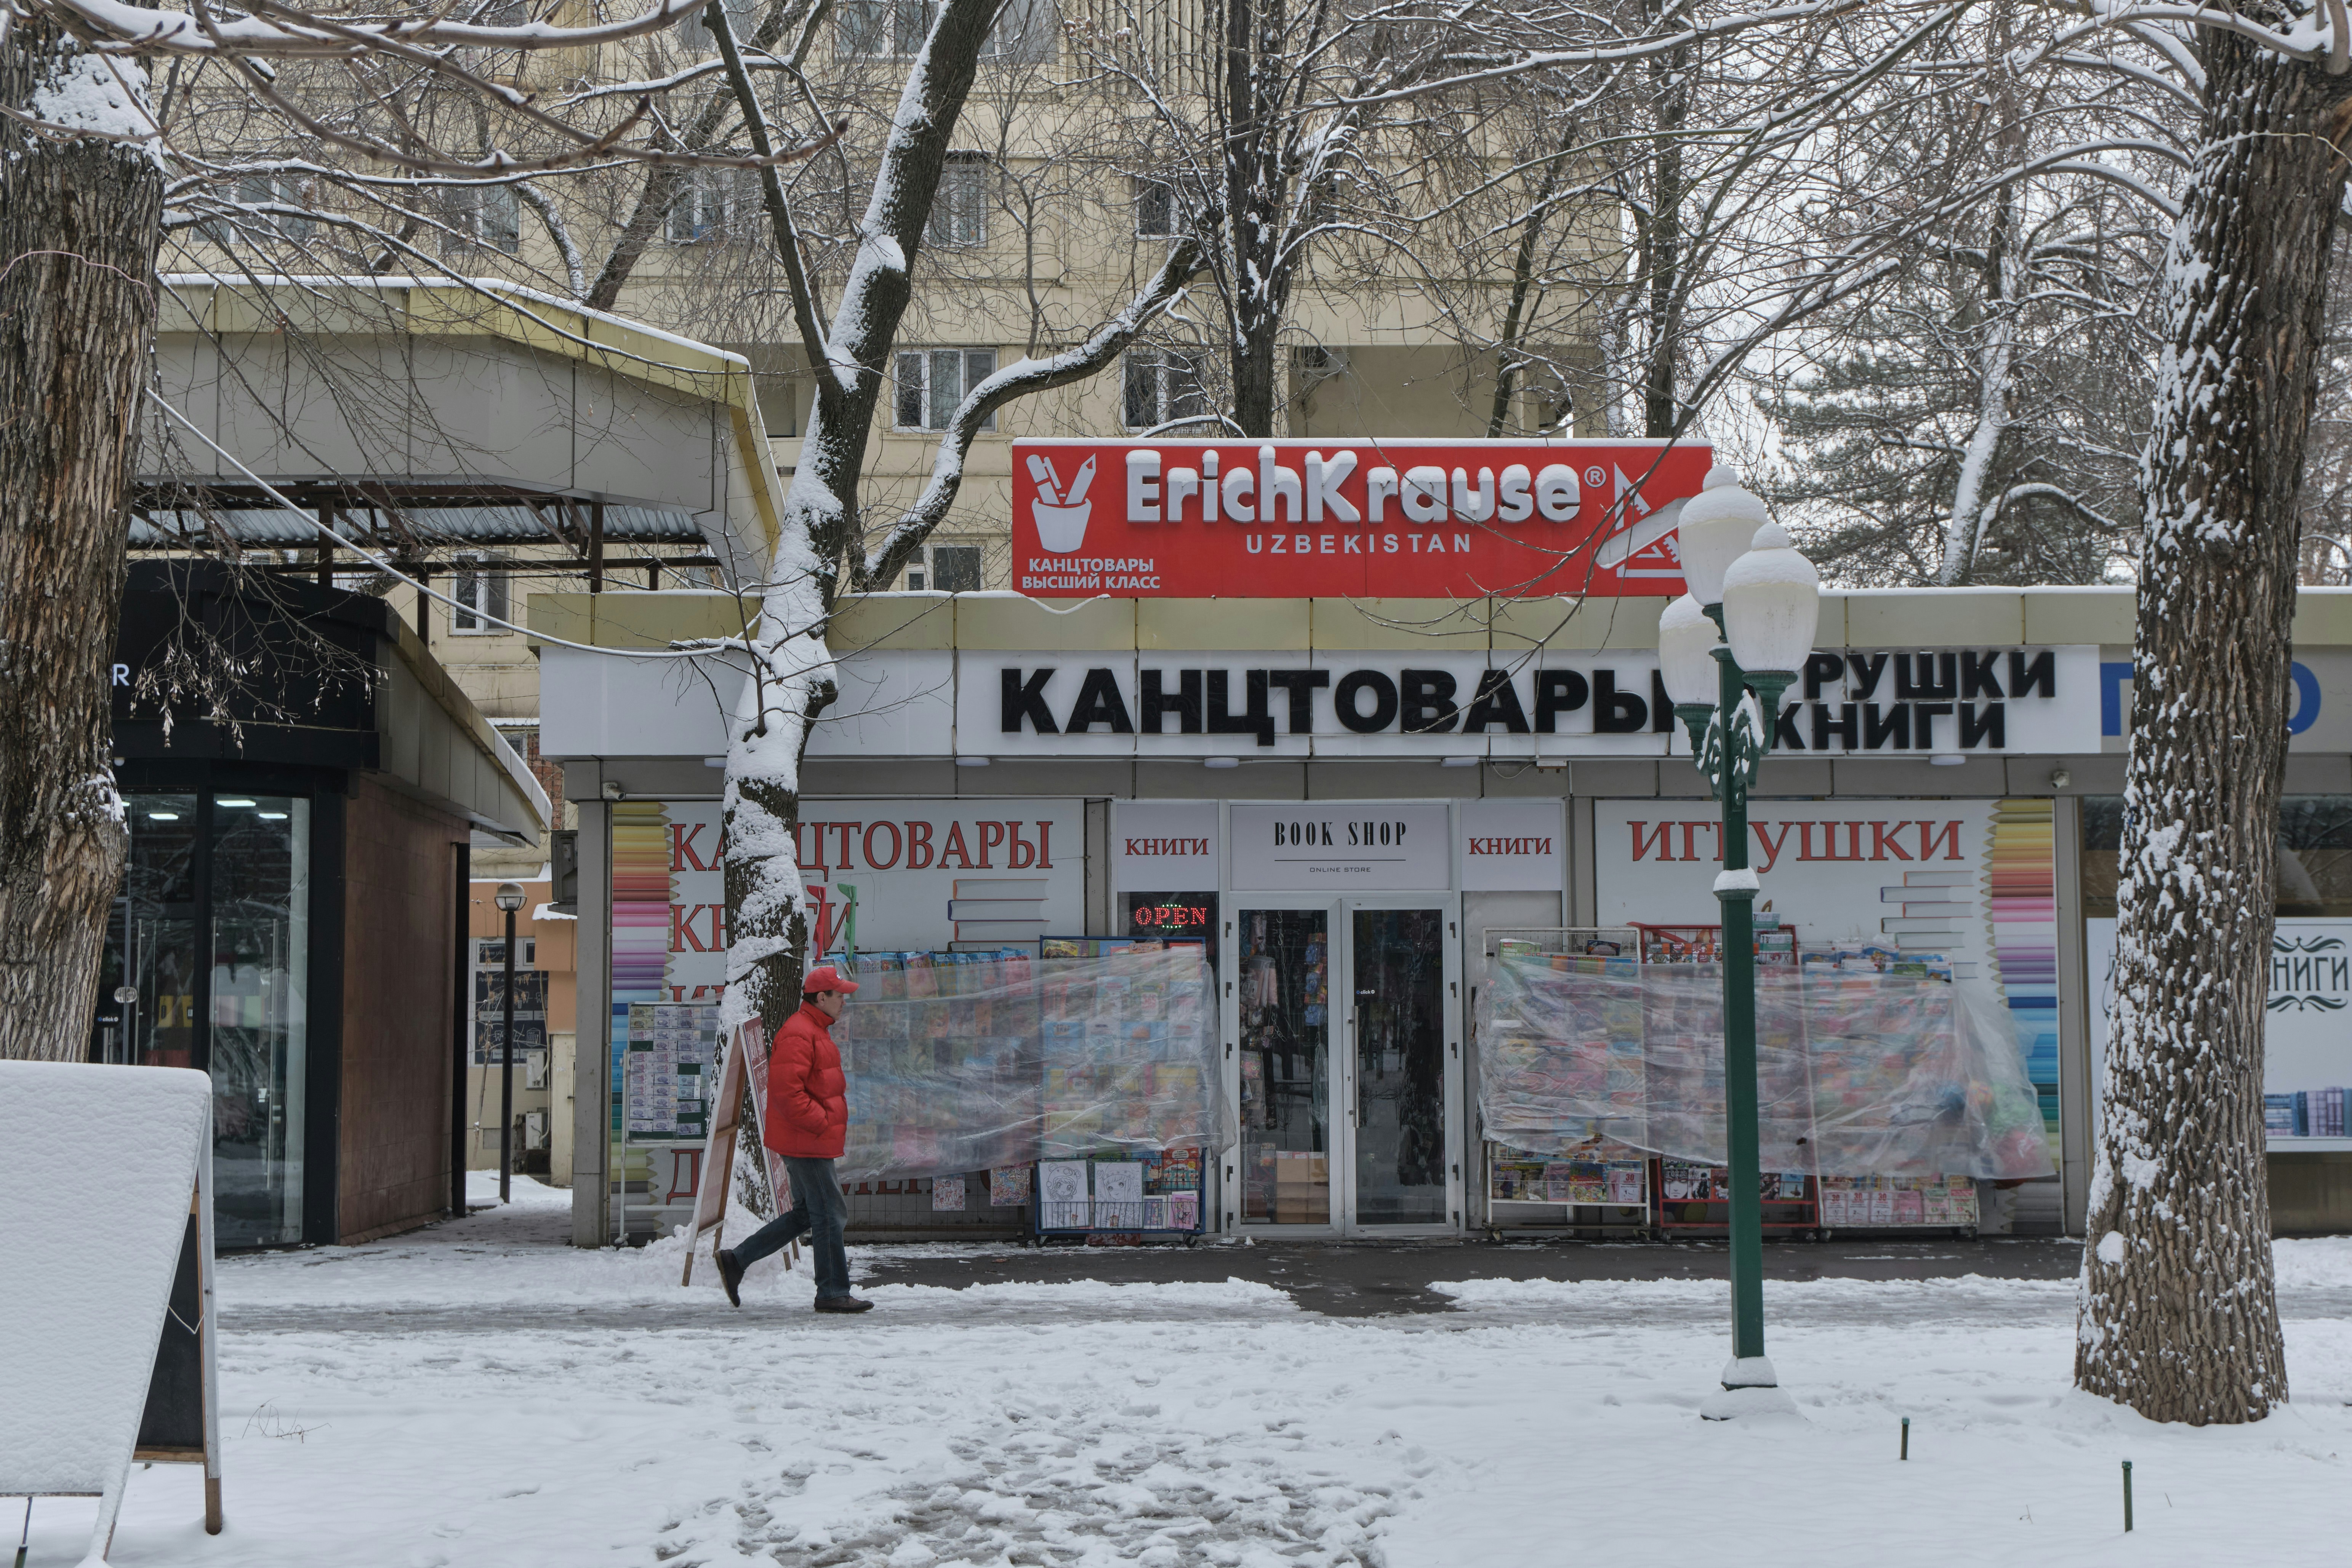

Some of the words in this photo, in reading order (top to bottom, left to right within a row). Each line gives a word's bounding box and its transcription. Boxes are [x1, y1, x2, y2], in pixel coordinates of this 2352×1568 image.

[1246, 533, 1471, 555] UZBEKISTAN
[1029, 558, 1154, 575] КАНЦТОВАРЫ
[1022, 572, 1100, 589] ВЫСШИЙ
[1105, 575, 1161, 589] КЛАСС
[1744, 651, 2055, 700] РУШКИ
[1001, 668, 1675, 747] КАНЦТОВАРЫ
[1770, 700, 2005, 749] КНИГИ
[1275, 822, 1334, 846] BOOK
[1348, 822, 1406, 846] SHOP
[1469, 838, 1552, 854] КНИГИ
[669, 821, 1054, 882] КЦТОВАРЫ
[1125, 838, 1209, 855] КНИГИ
[669, 902, 859, 953] КНИ
[1135, 907, 1207, 926] OPEN
[2272, 957, 2349, 991] НИГИ
